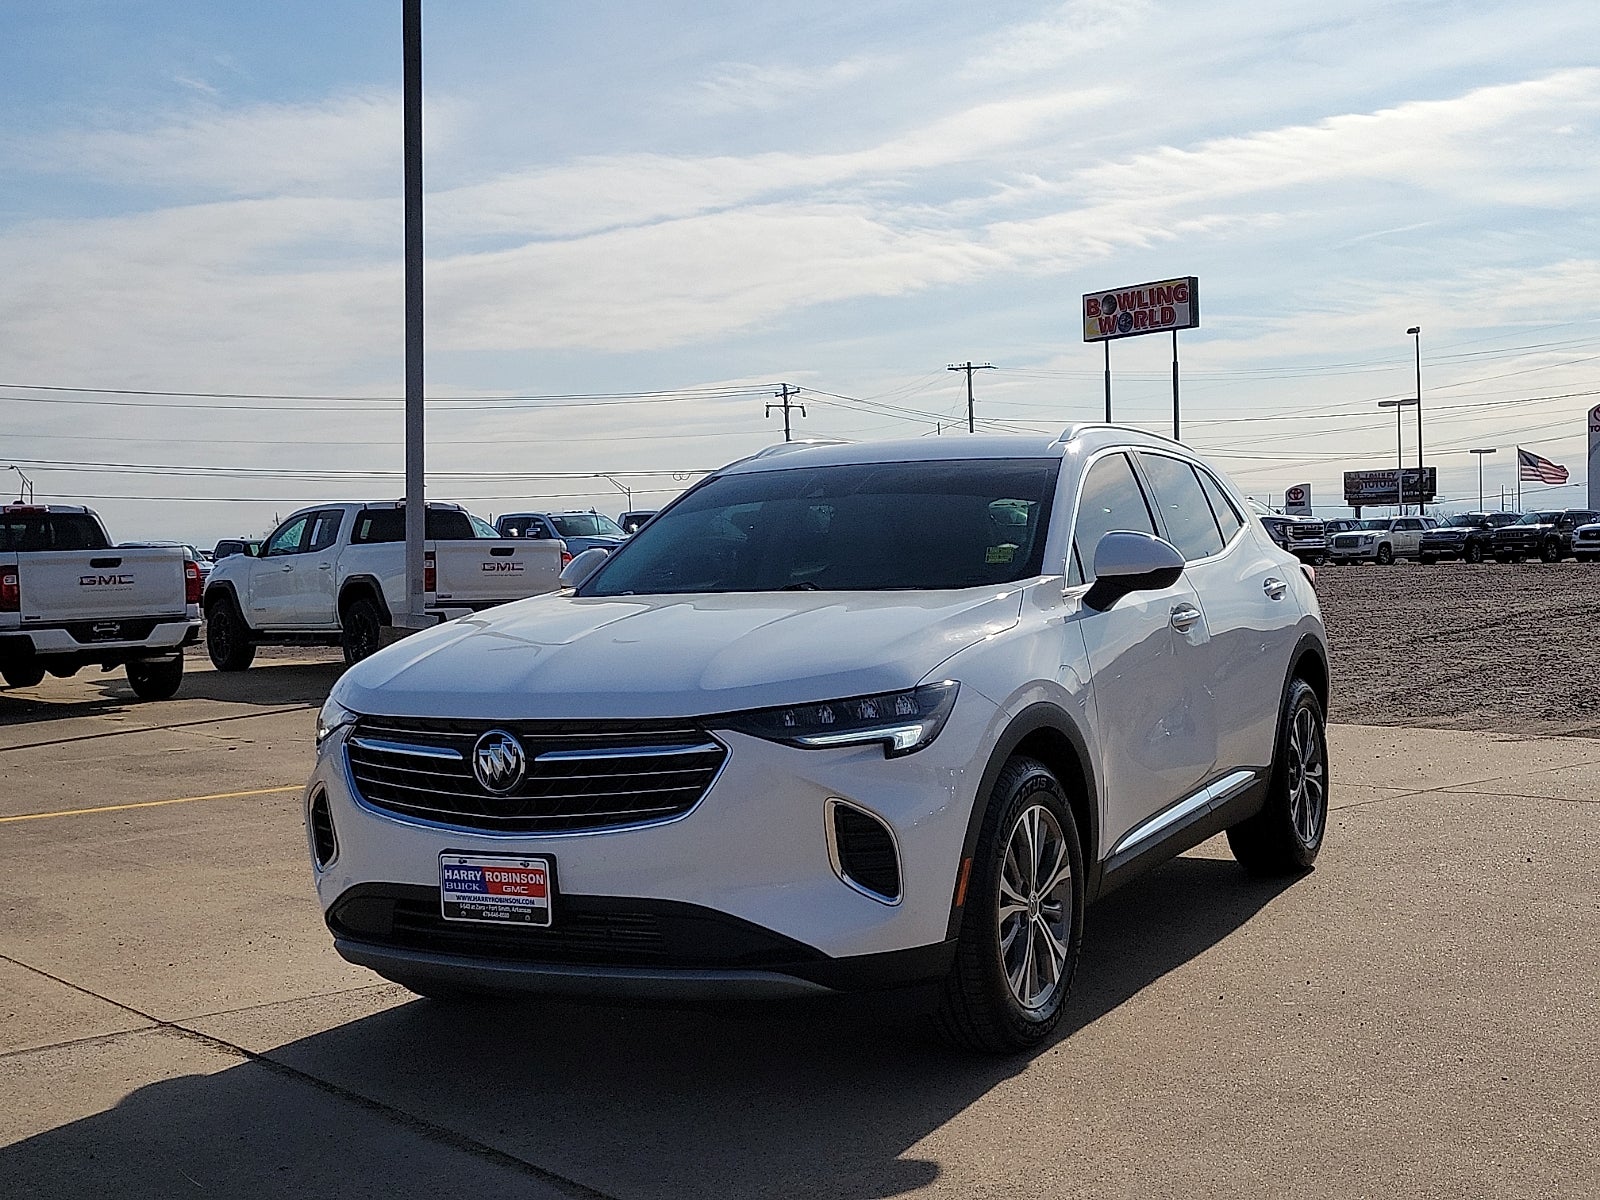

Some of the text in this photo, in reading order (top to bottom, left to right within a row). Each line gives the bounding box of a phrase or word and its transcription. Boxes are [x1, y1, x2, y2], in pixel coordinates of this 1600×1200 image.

[1086, 283, 1189, 318] BOWLING
[1098, 306, 1176, 335] WORLD
[481, 562, 525, 571] GMC
[79, 574, 135, 586] GMC
[444, 869, 545, 885] HARRY ROBINSON
[445, 881, 529, 894] BUICK GMC
[455, 894, 536, 906] WWW.HARRYROBINSON.COM
